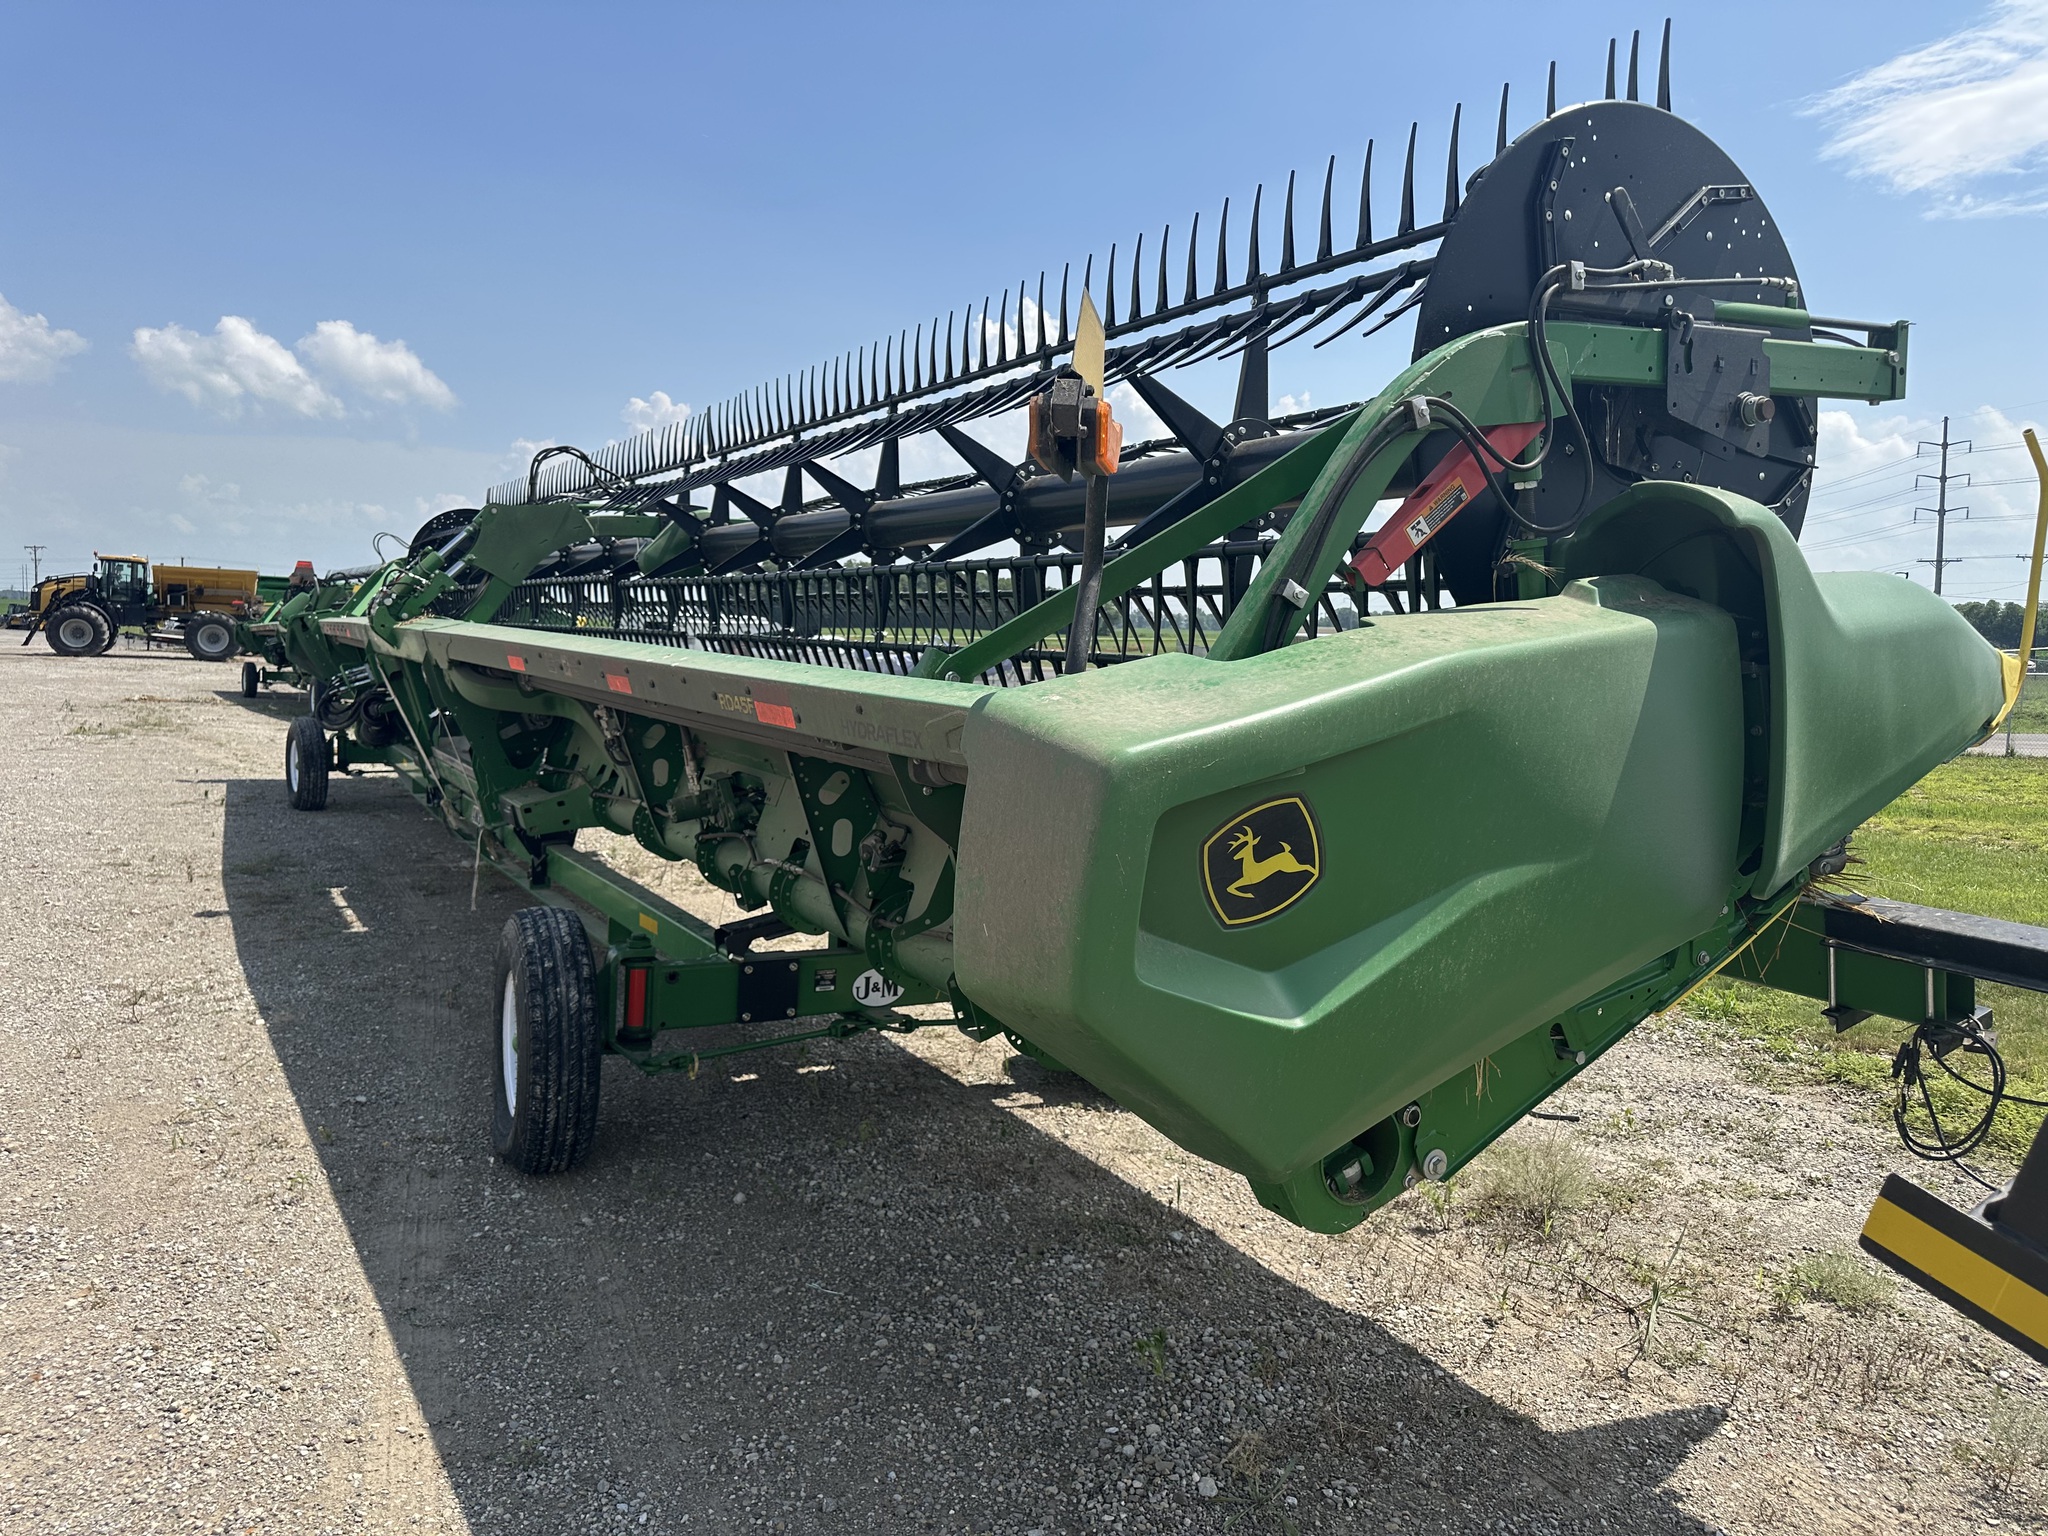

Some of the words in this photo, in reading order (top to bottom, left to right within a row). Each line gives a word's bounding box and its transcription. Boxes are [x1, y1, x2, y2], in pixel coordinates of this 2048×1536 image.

[1433, 484, 1456, 506] WARNING
[840, 718, 924, 750] HYDRAFLEX
[855, 976, 899, 1000] J&M
